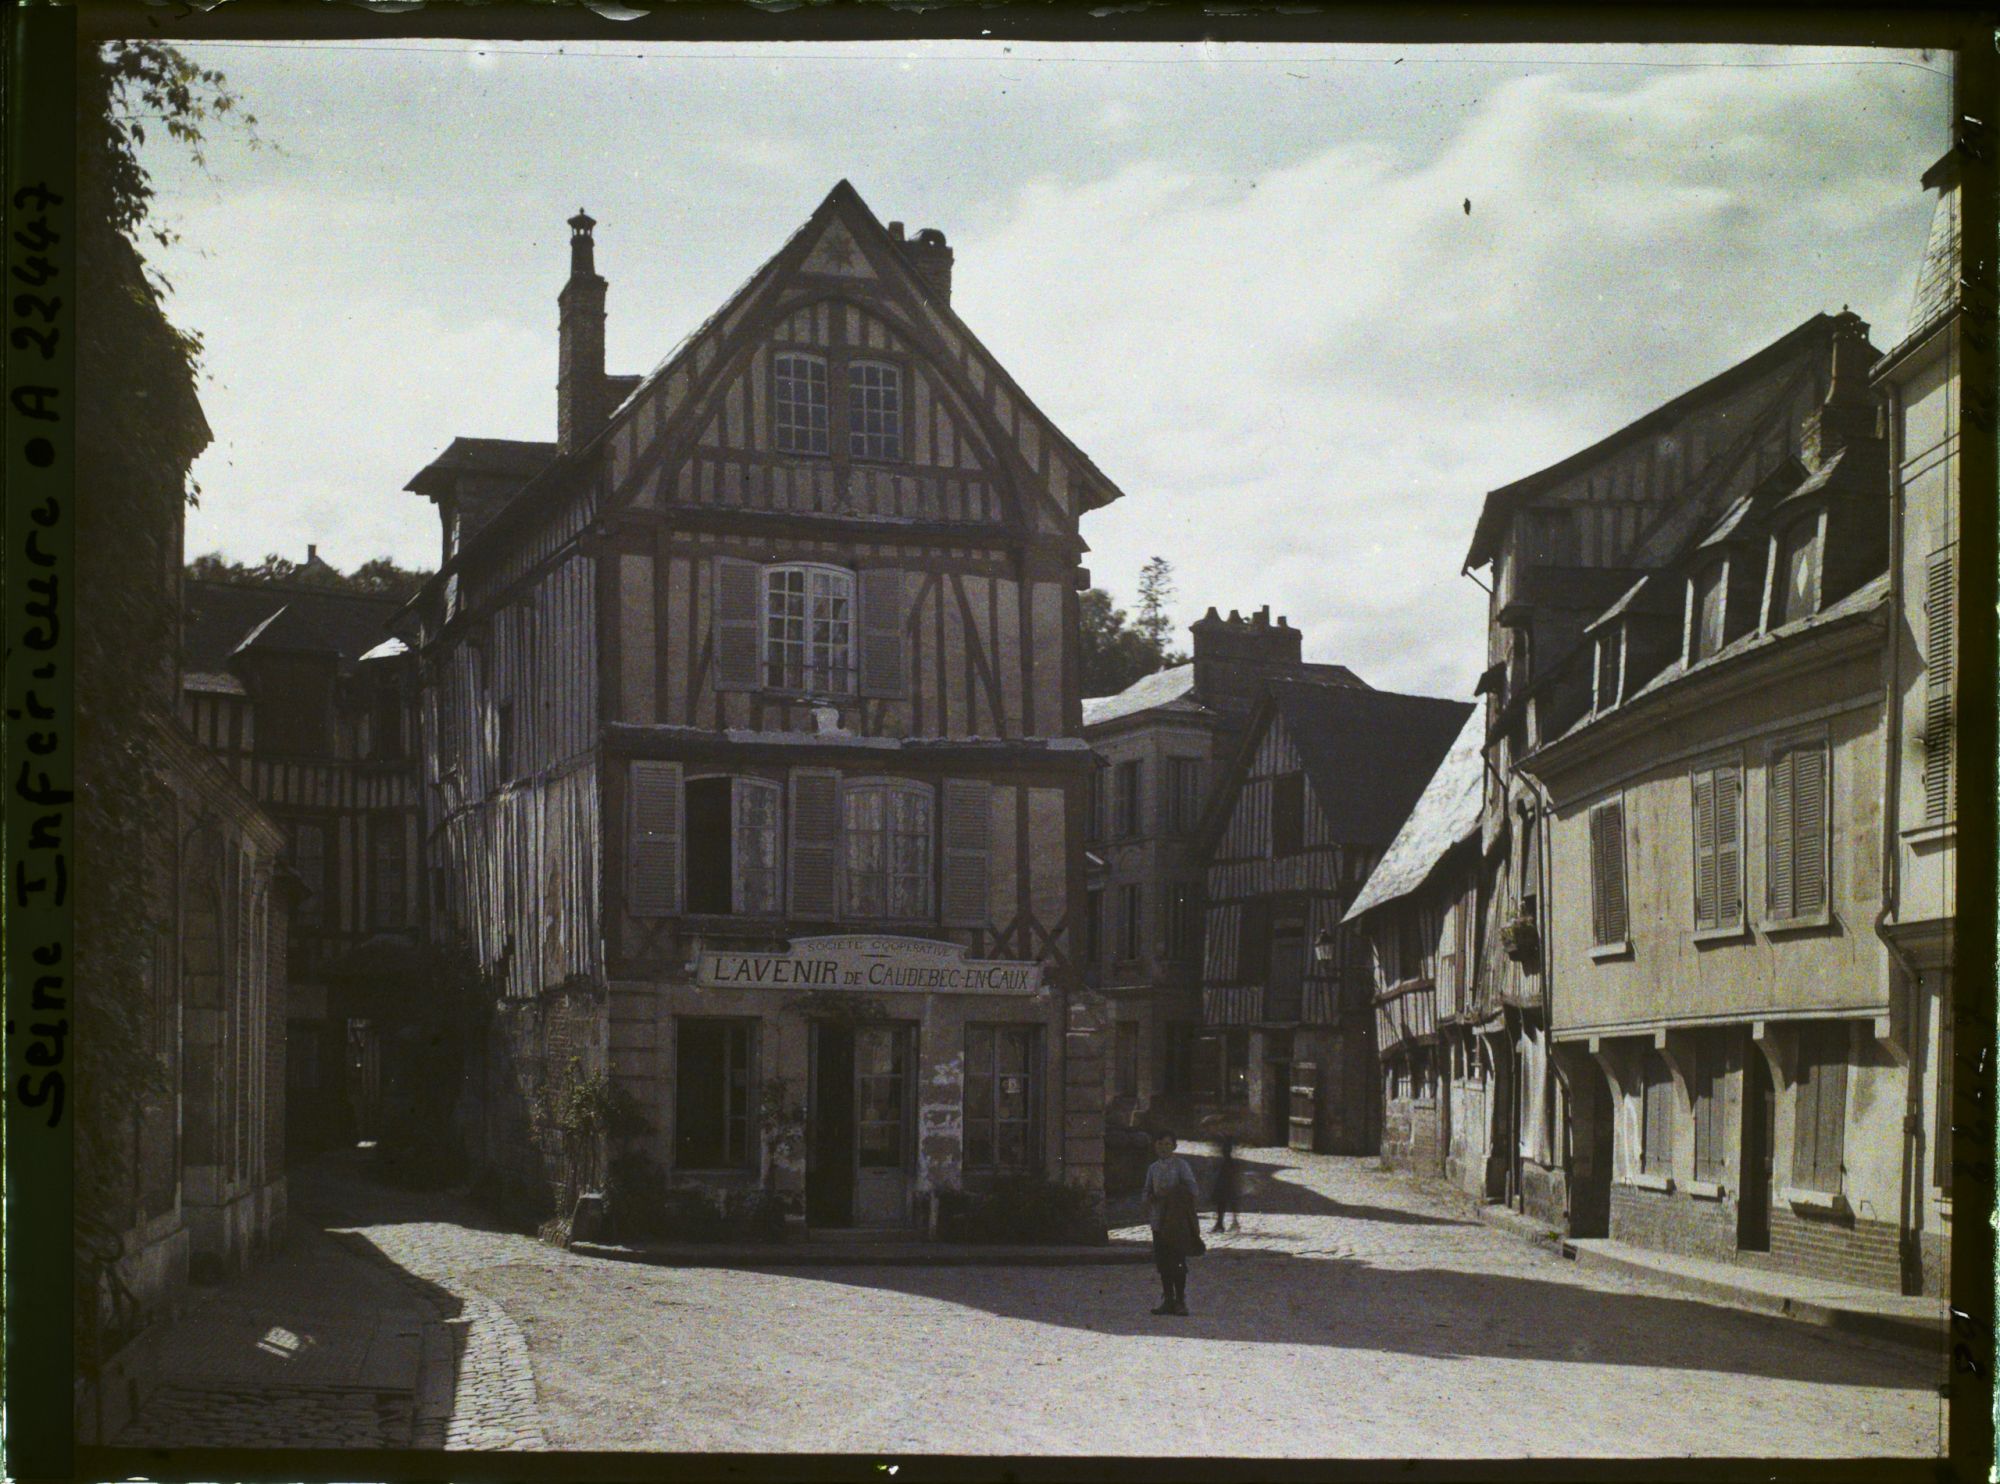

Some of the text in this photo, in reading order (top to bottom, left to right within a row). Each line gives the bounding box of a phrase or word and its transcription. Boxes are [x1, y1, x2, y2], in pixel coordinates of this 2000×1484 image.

[12, 181, 64, 360] 22447
[10, 385, 60, 422] A
[713, 957, 838, 985] L'AVENIR
[843, 971, 863, 986] DE
[13, 942, 67, 1129] Seine
